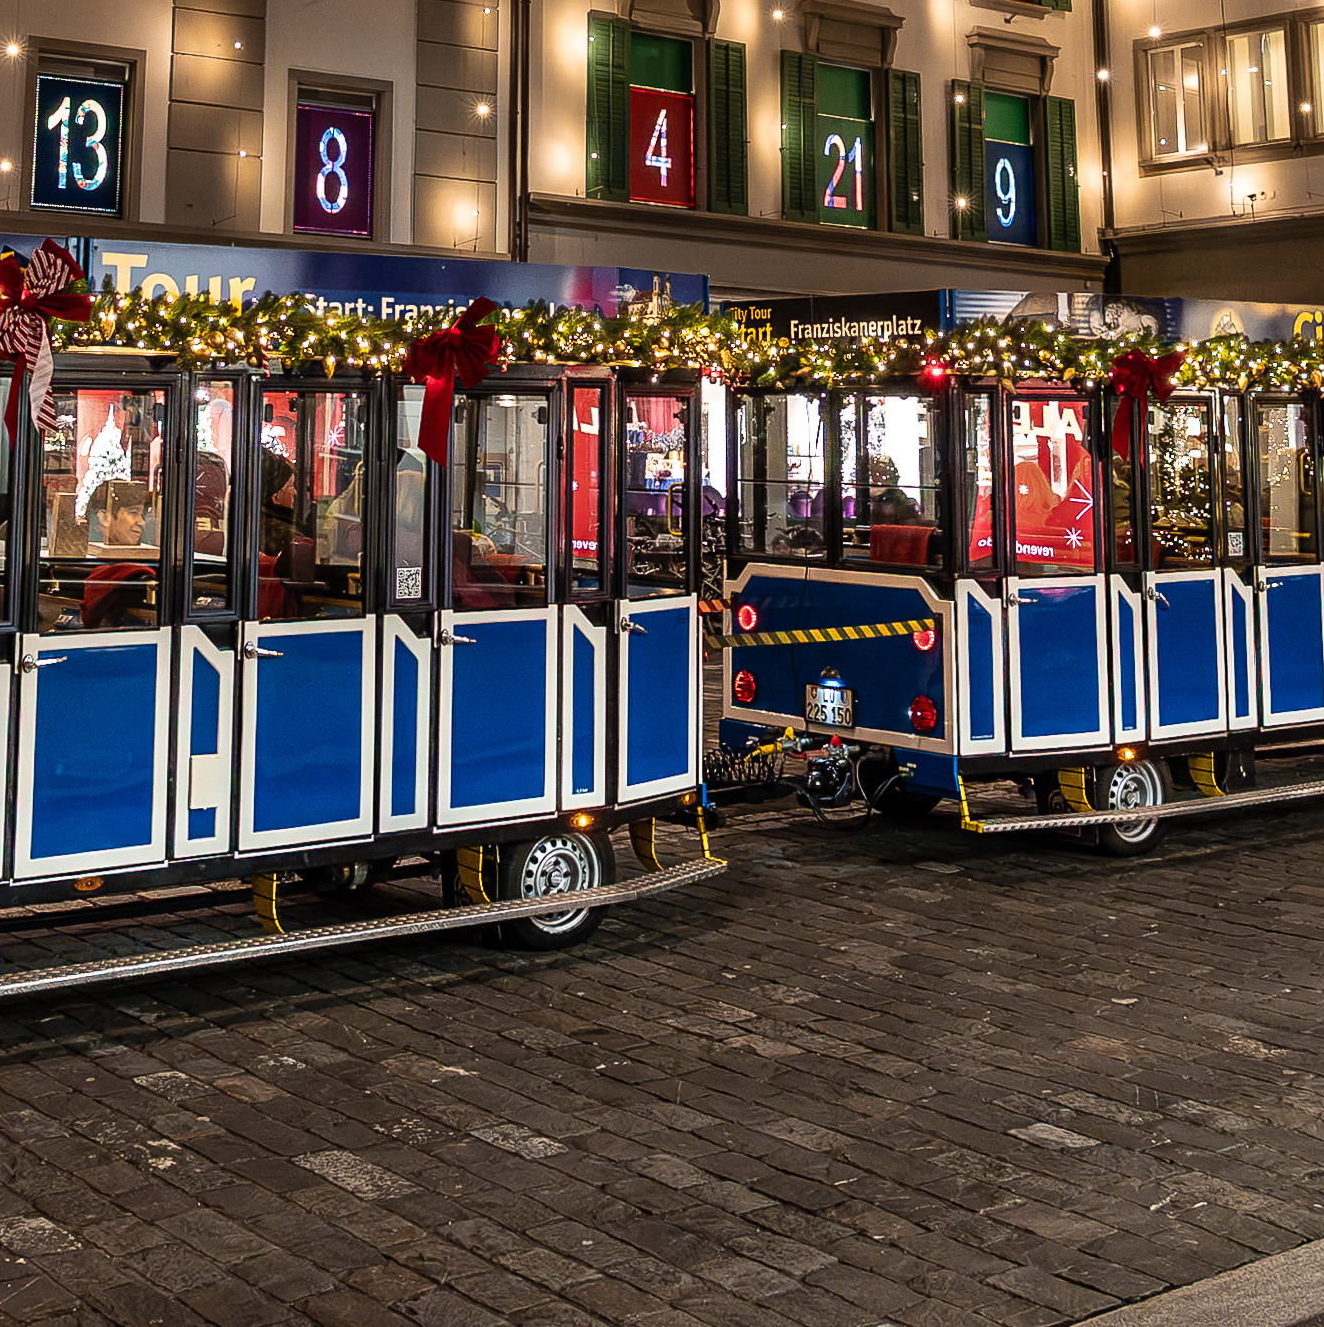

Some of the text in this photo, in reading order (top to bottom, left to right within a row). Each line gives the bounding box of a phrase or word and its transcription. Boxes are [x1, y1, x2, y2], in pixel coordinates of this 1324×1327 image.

[48, 97, 107, 190] 13
[317, 127, 348, 213] 8
[646, 110, 671, 186] 4
[824, 134, 862, 210] 21
[995, 158, 1015, 227] 9
[749, 306, 772, 320] Tour
[790, 316, 922, 342] Franziskanerplatz
[807, 702, 851, 725] 225 150
